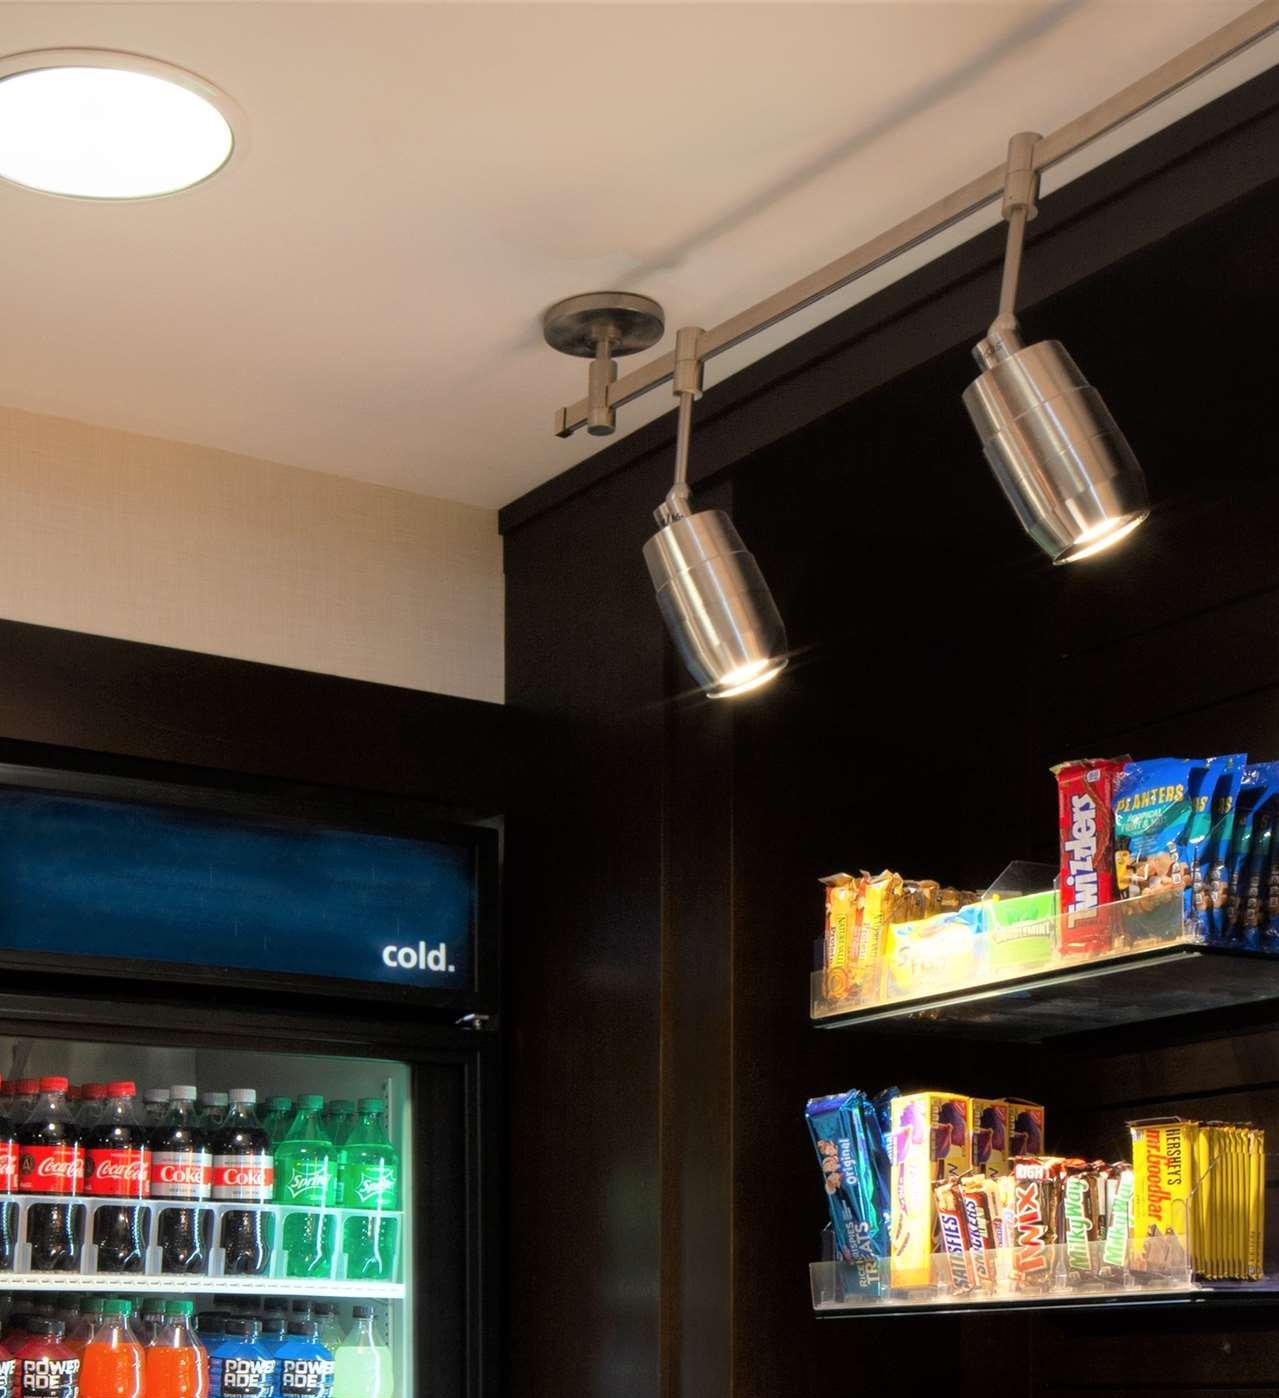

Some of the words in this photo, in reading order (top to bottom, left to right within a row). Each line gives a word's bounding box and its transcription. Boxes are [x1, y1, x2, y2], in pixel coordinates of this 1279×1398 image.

[1116, 783, 1184, 813] PLANTERS
[1065, 793, 1099, 929] Twizzlers
[382, 941, 455, 972] cold.
[840, 1138, 857, 1185] Original
[1165, 1128, 1182, 1186] HERSHEY'S
[161, 1165, 202, 1183] Coke
[223, 1168, 265, 1185] Coke
[855, 1221, 880, 1285] TREATS
[23, 1359, 80, 1377] POWER
[23, 1374, 60, 1390] ADE
[223, 1373, 260, 1388] ADE
[283, 1374, 319, 1388] ADE
